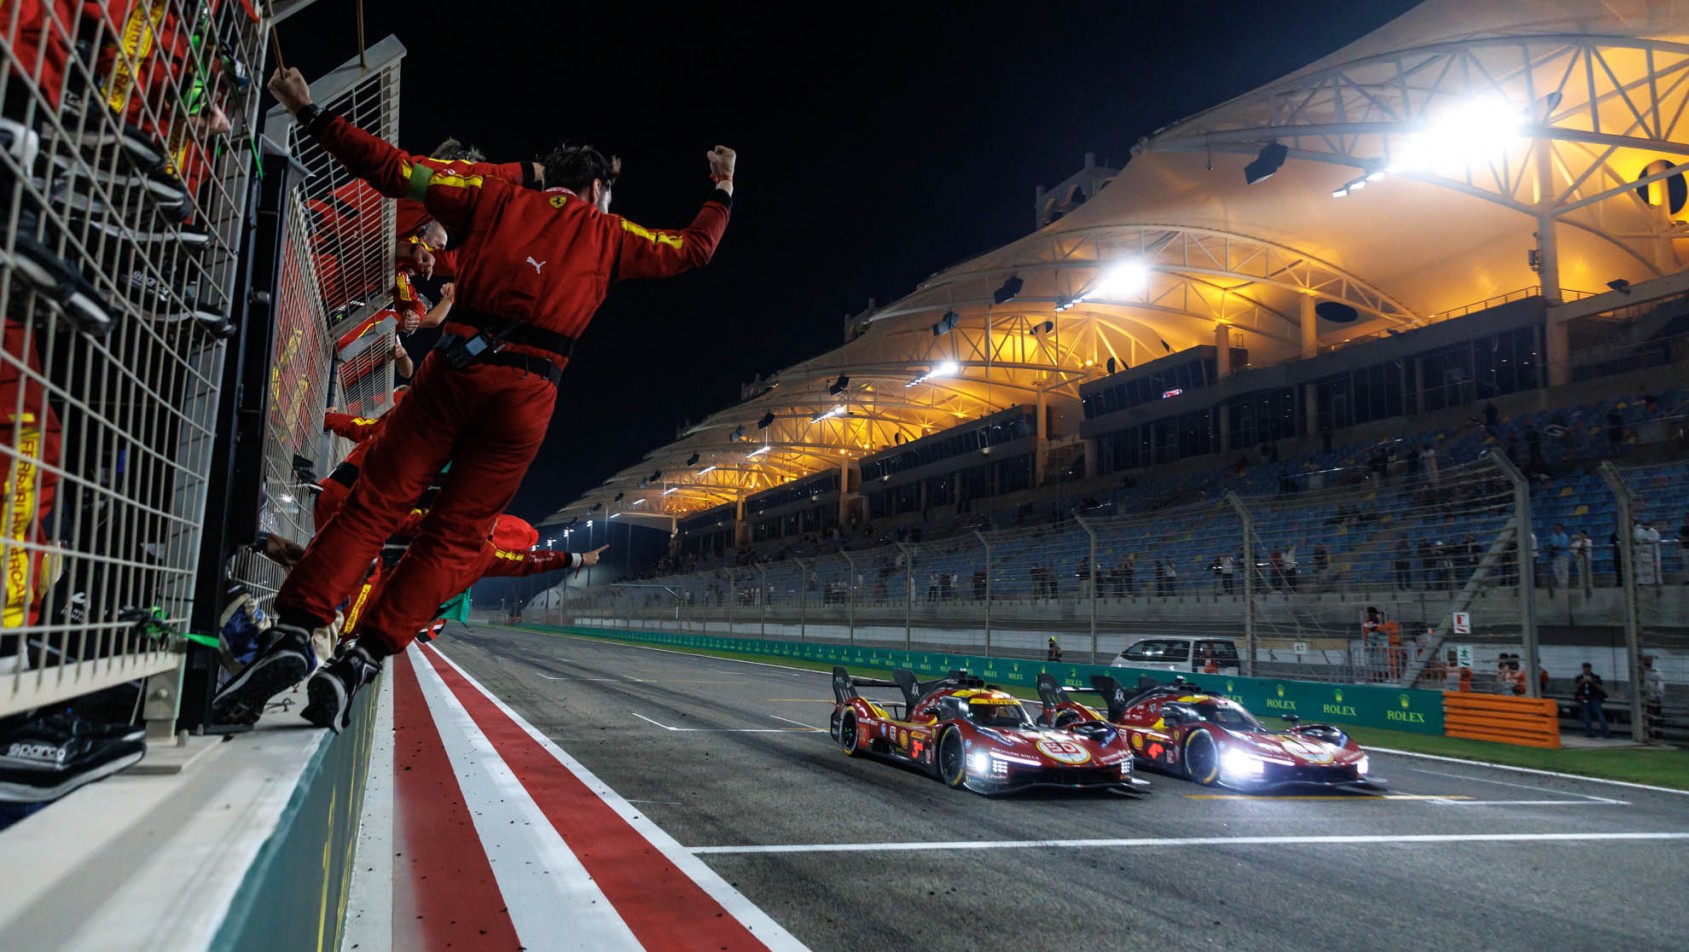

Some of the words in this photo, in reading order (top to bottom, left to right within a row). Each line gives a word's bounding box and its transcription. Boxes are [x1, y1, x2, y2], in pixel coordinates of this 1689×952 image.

[1221, 695, 1244, 705] OLEX
[1266, 699, 1296, 710] ROLEX
[1323, 704, 1357, 716] ROLEX
[1387, 710, 1425, 723] ROLEX
[9, 743, 66, 762] sparco
[1046, 742, 1078, 752] 50
